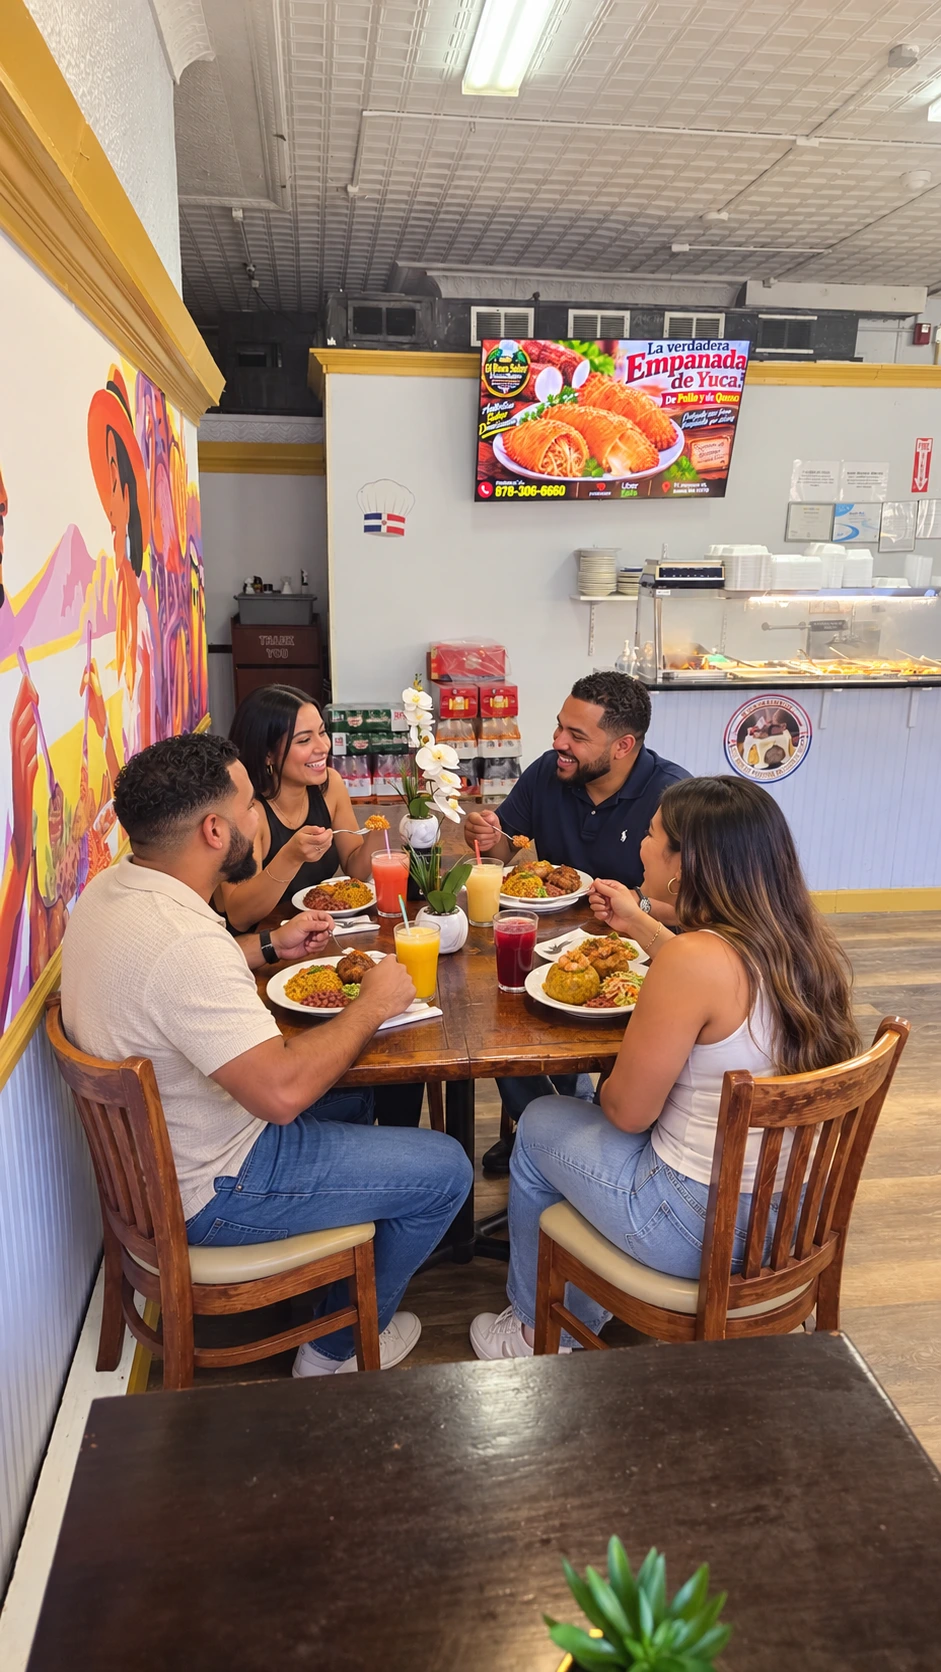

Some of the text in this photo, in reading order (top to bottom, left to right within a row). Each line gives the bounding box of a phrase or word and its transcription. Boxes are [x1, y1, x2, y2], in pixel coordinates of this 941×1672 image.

[647, 340, 730, 355] La verdadera
[625, 349, 747, 384] Empanada
[671, 372, 694, 389] de
[258, 635, 295, 646] THANK
[266, 648, 289, 659] YOU
